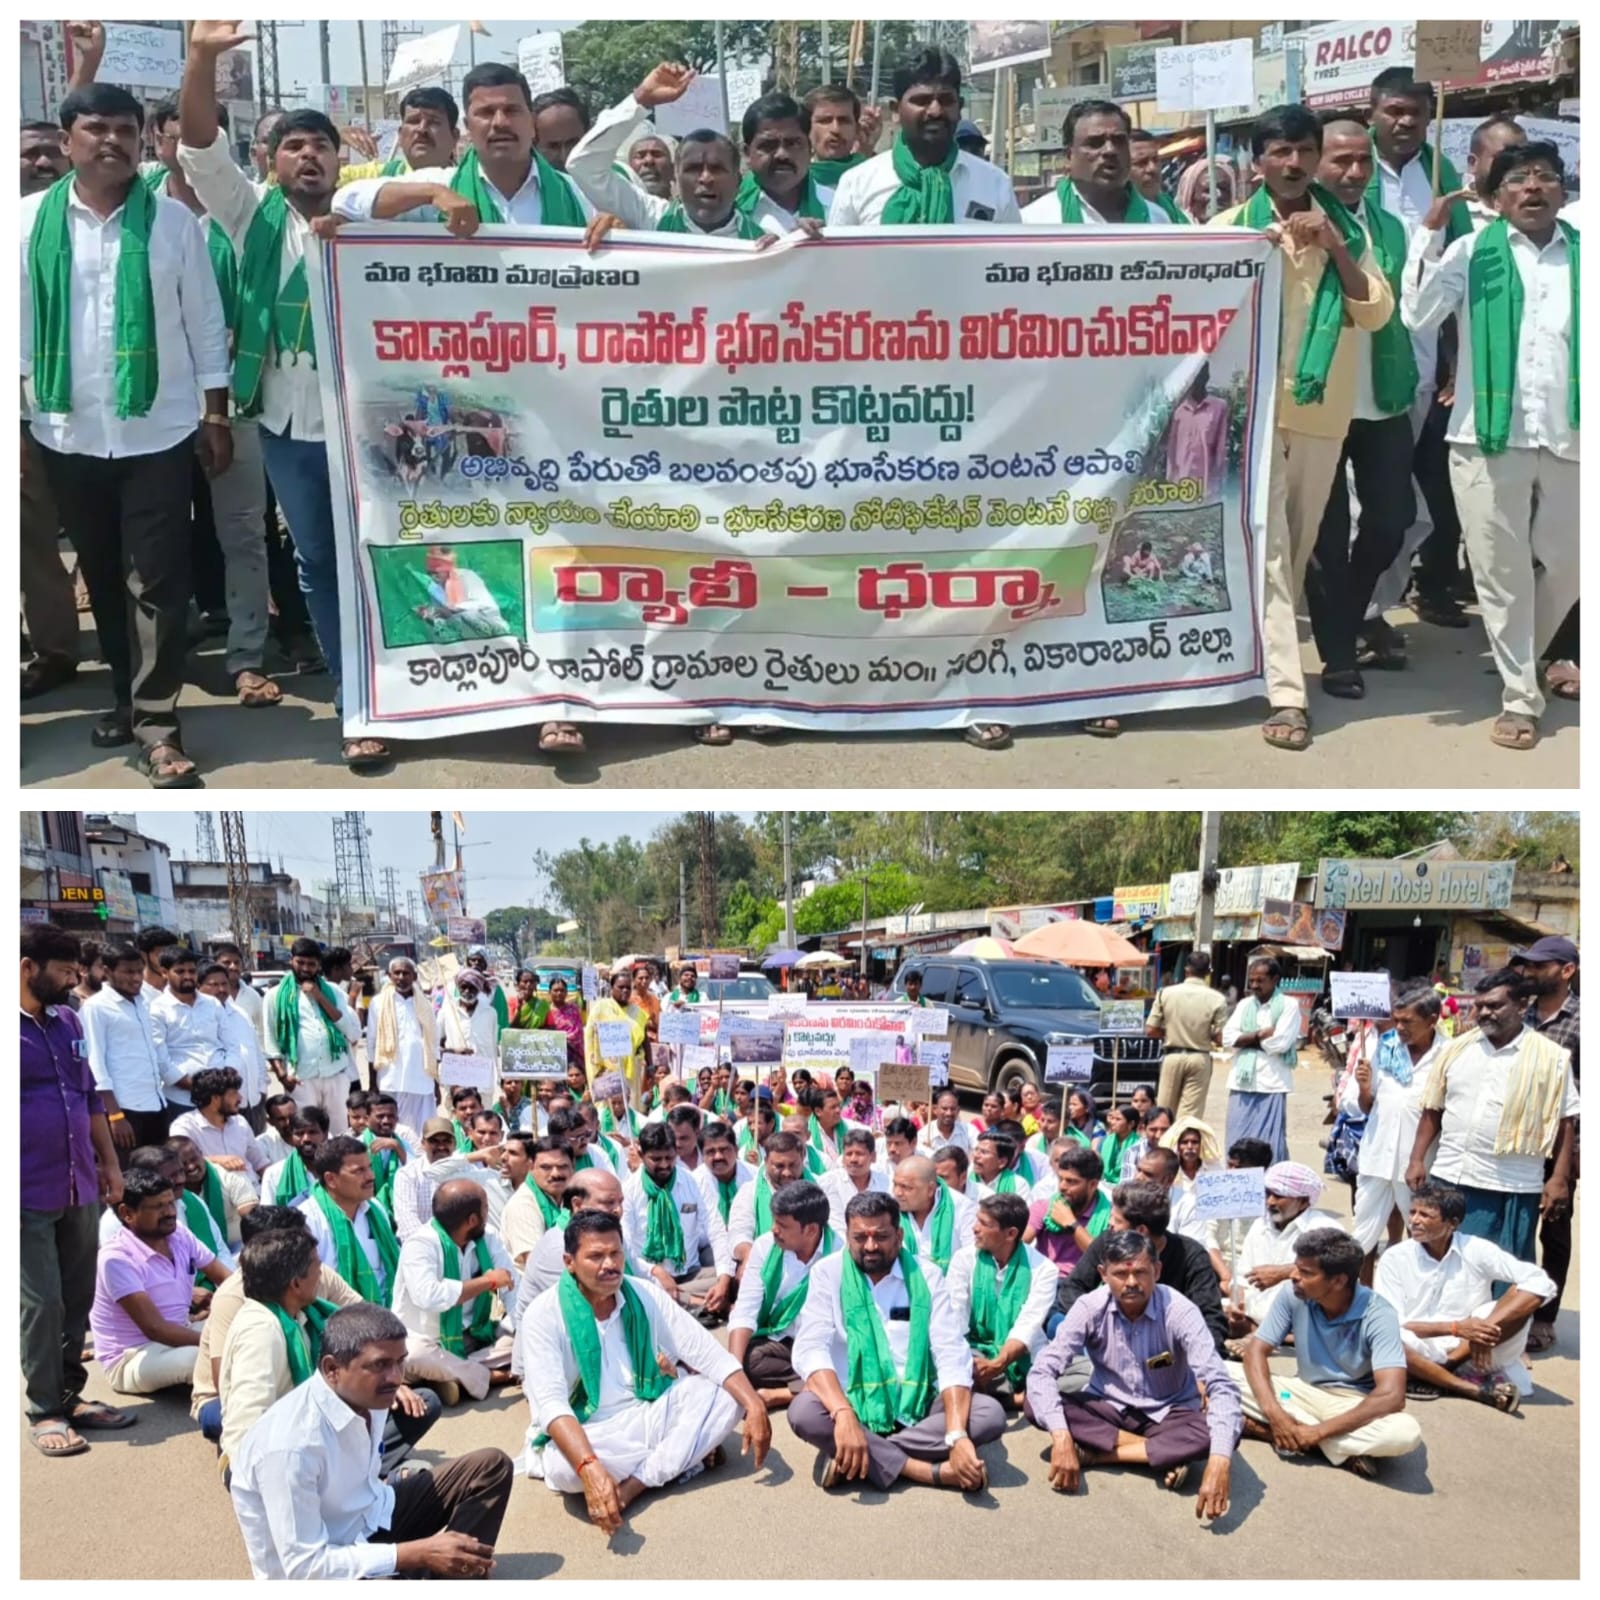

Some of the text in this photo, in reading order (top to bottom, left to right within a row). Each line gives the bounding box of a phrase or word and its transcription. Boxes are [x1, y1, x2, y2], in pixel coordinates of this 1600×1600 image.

[1315, 26, 1392, 67] RALCO
[1314, 66, 1340, 81] TYRES
[1325, 91, 1343, 103] SUPER
[365, 262, 410, 283] మా
[418, 262, 498, 287] భూమి
[985, 262, 1029, 283] మా
[1037, 261, 1113, 285] భూమి
[576, 307, 708, 365] రాపోల్
[716, 301, 950, 374] భూసేకరణను
[601, 384, 974, 443] రైతుల పొట్ట కొట్టవద్దు!
[568, 450, 661, 481] పేరుతో
[669, 456, 817, 489] బలవంతపు
[825, 450, 960, 488] భూసేకరణ
[967, 445, 1056, 481] వెంటనే
[400, 499, 497, 540] రైతులకు
[506, 499, 601, 536] న్యాయం
[608, 497, 701, 532] చేయాలి
[724, 498, 845, 537] భూసేకరణ
[850, 494, 982, 534] నోటిఫికేషన్
[986, 489, 1070, 527] వెంటనే
[553, 559, 759, 627] ర్యాలీ
[546, 644, 645, 683] రాపోల్
[650, 648, 757, 690] గ్రామాల
[763, 648, 860, 692] రైతులు
[1024, 622, 1172, 673] వికారాబాద్
[1178, 624, 1235, 664] జిల్లా
[92, 887, 104, 901] B
[1349, 869, 1485, 904] Red Rose Hotel
